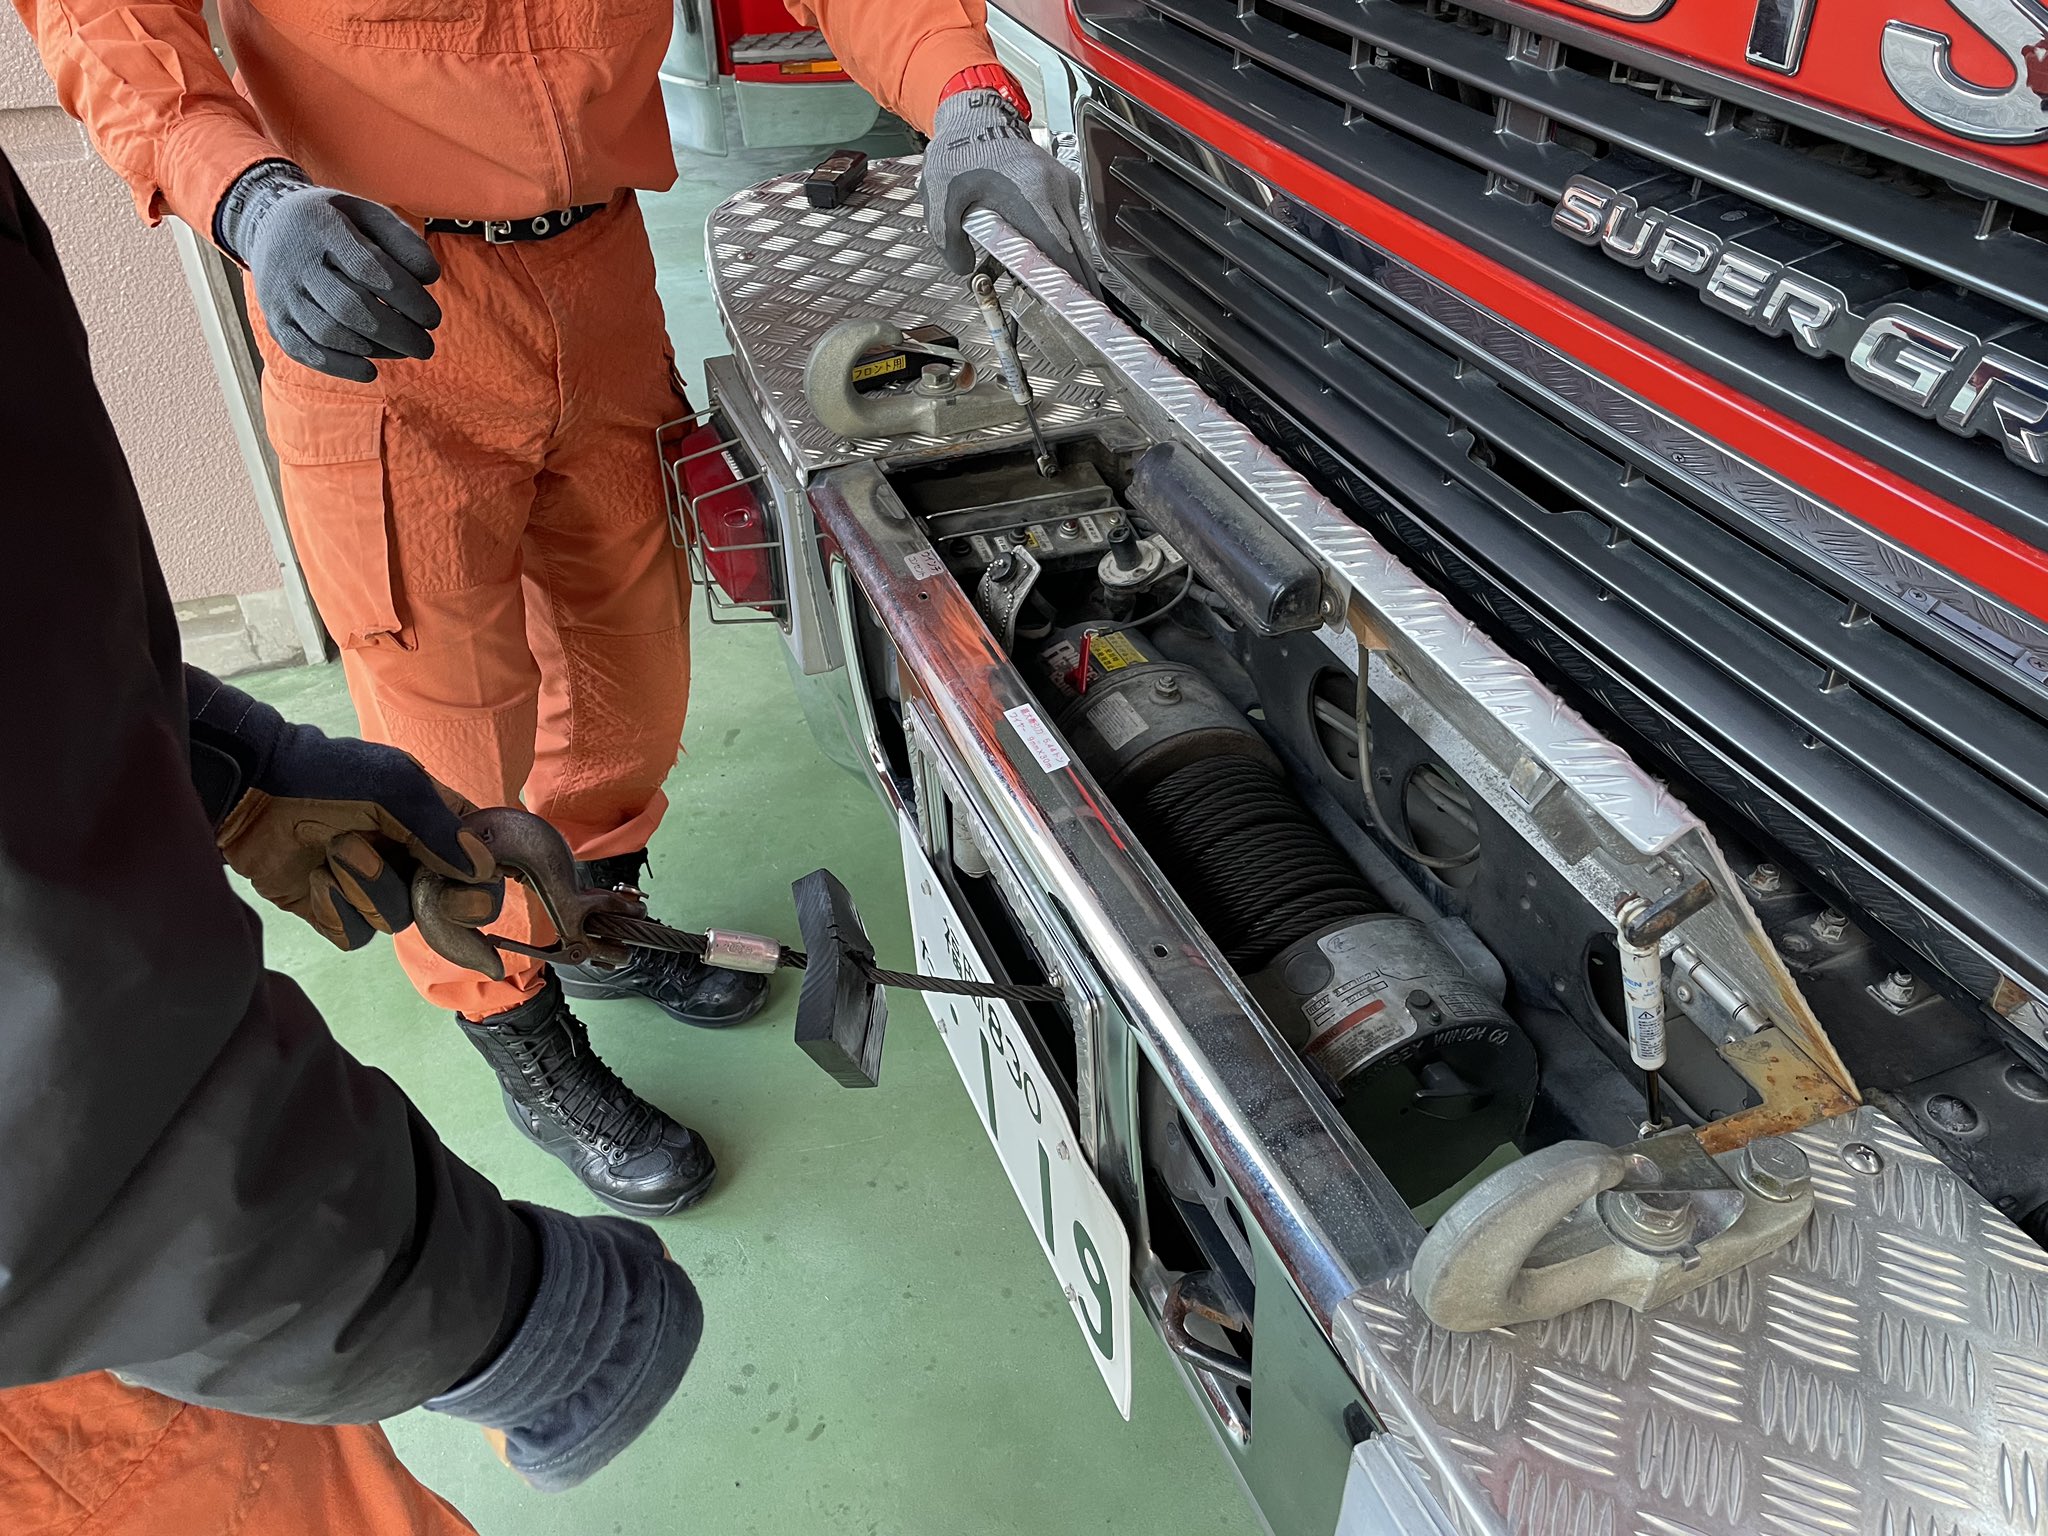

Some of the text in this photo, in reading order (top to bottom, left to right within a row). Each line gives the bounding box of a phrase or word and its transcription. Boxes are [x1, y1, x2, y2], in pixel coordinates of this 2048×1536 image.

[1555, 186, 1837, 349] SUPER
[853, 356, 904, 379] フロント用
[987, 1002, 1042, 1125] 830
